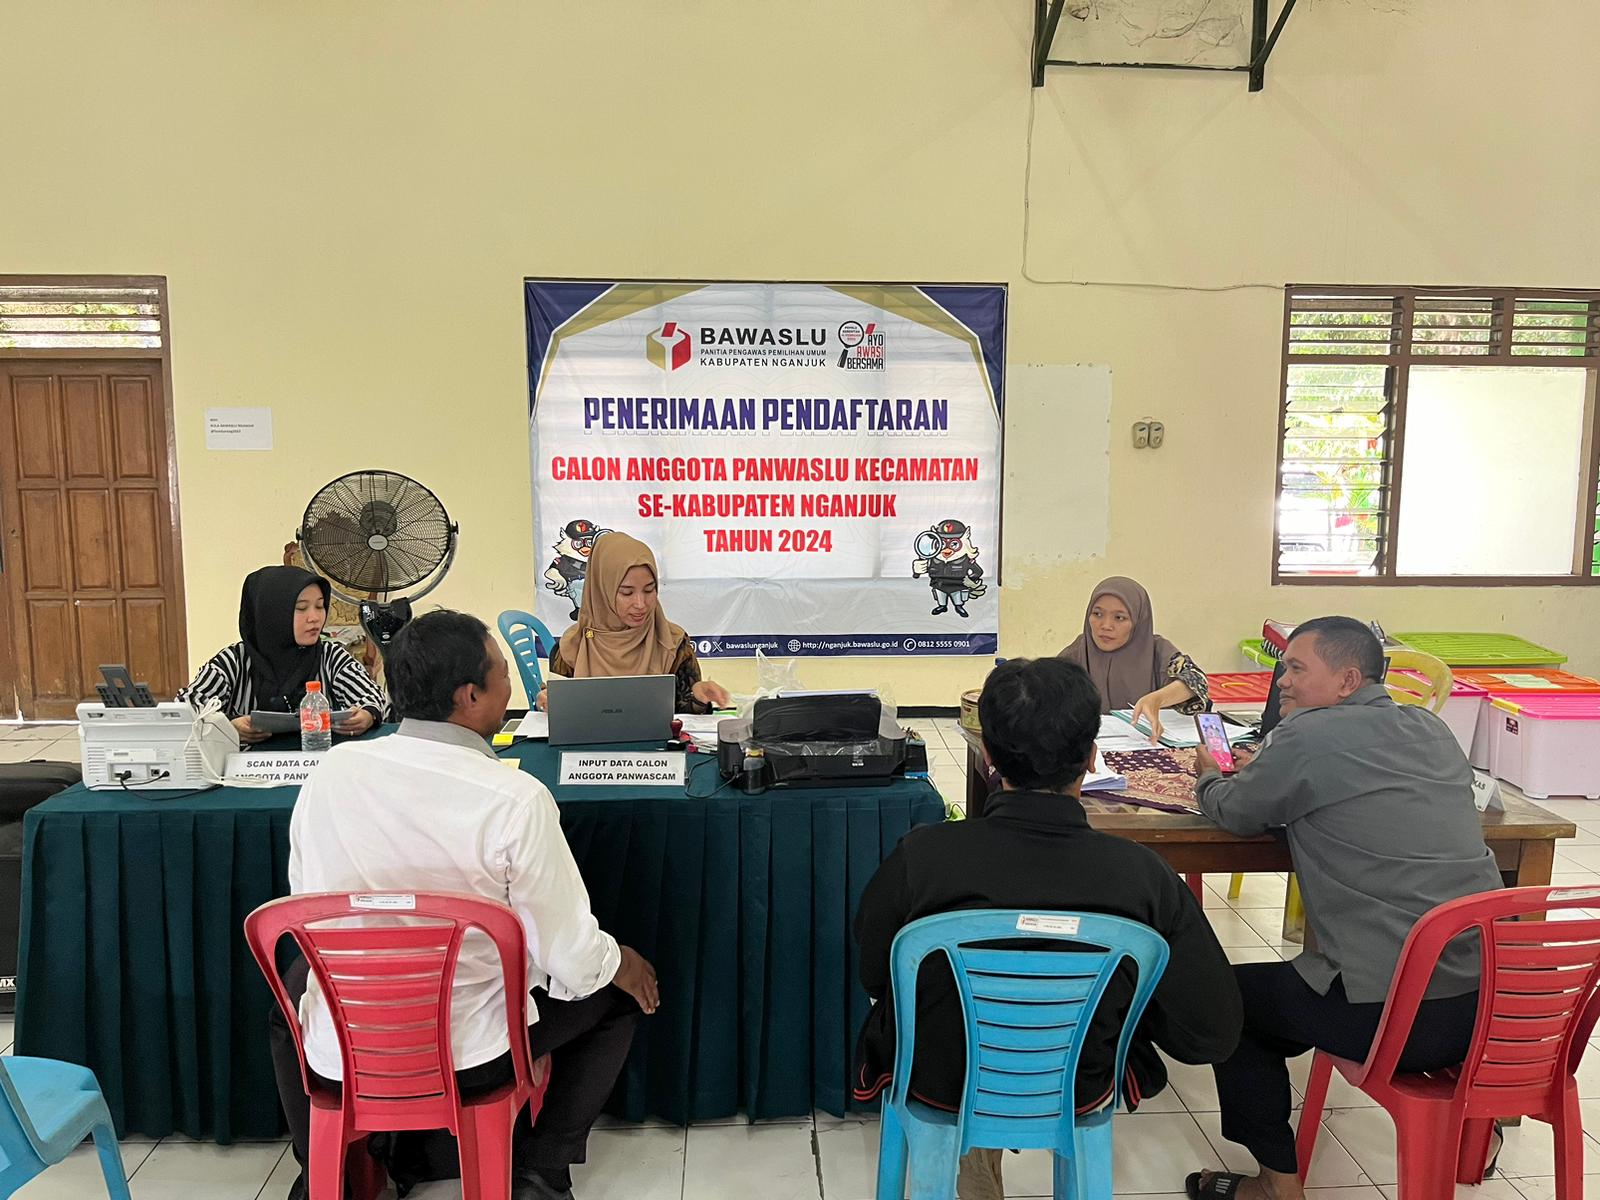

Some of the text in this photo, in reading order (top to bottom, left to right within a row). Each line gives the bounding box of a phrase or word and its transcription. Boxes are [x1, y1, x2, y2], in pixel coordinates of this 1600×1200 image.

[700, 327, 827, 346] BAWASLU
[867, 334, 884, 346] AYO
[700, 348, 728, 356] PANITIA
[728, 348, 767, 356] PENGAWAS
[856, 345, 884, 358] AWASI
[700, 357, 827, 367] KABUPATEN NGANJUK
[846, 357, 884, 370] BERSAMA
[583, 396, 949, 434] PENERIMAAN PENDAFTARAN
[551, 456, 979, 482] CALON ANGGOTA PANWASLU KECAMATAN
[638, 493, 897, 518] SE-KABUPATEN NGANJUK
[703, 529, 833, 553] TAHUN 2024
[918, 640, 935, 648] 0812
[953, 640, 970, 648] 0901
[246, 760, 273, 768] SCAN
[578, 759, 668, 767] INPUT DATA CALON
[568, 772, 677, 780] ANGGOTA PANWASCAM
